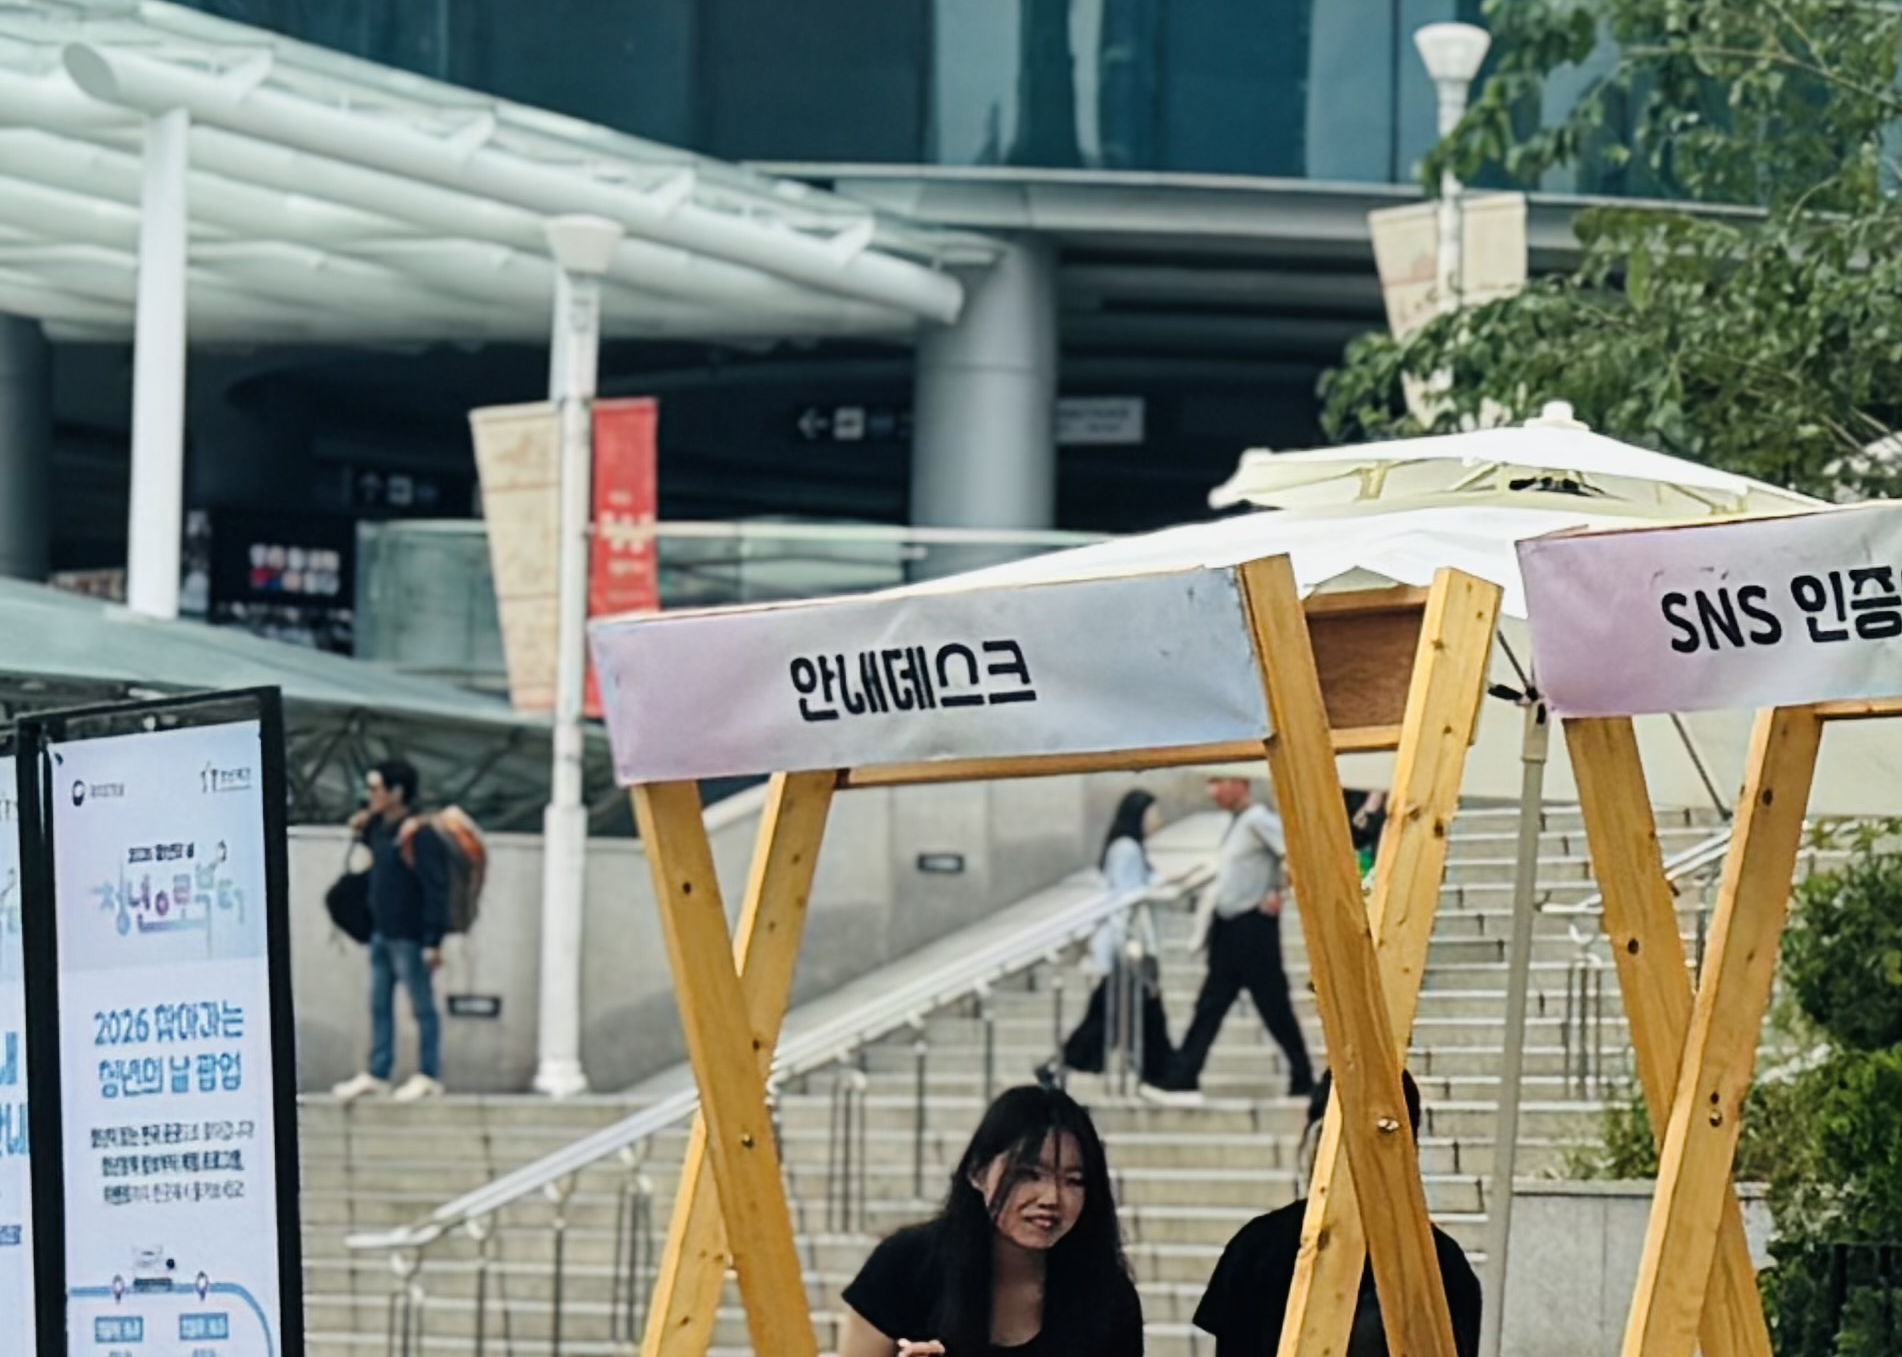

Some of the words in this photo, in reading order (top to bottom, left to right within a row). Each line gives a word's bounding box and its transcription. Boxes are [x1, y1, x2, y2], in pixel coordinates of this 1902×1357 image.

[1660, 584, 1782, 654] SNS
[790, 639, 1037, 722] 안내데스크
[94, 1008, 149, 1045] 2026
